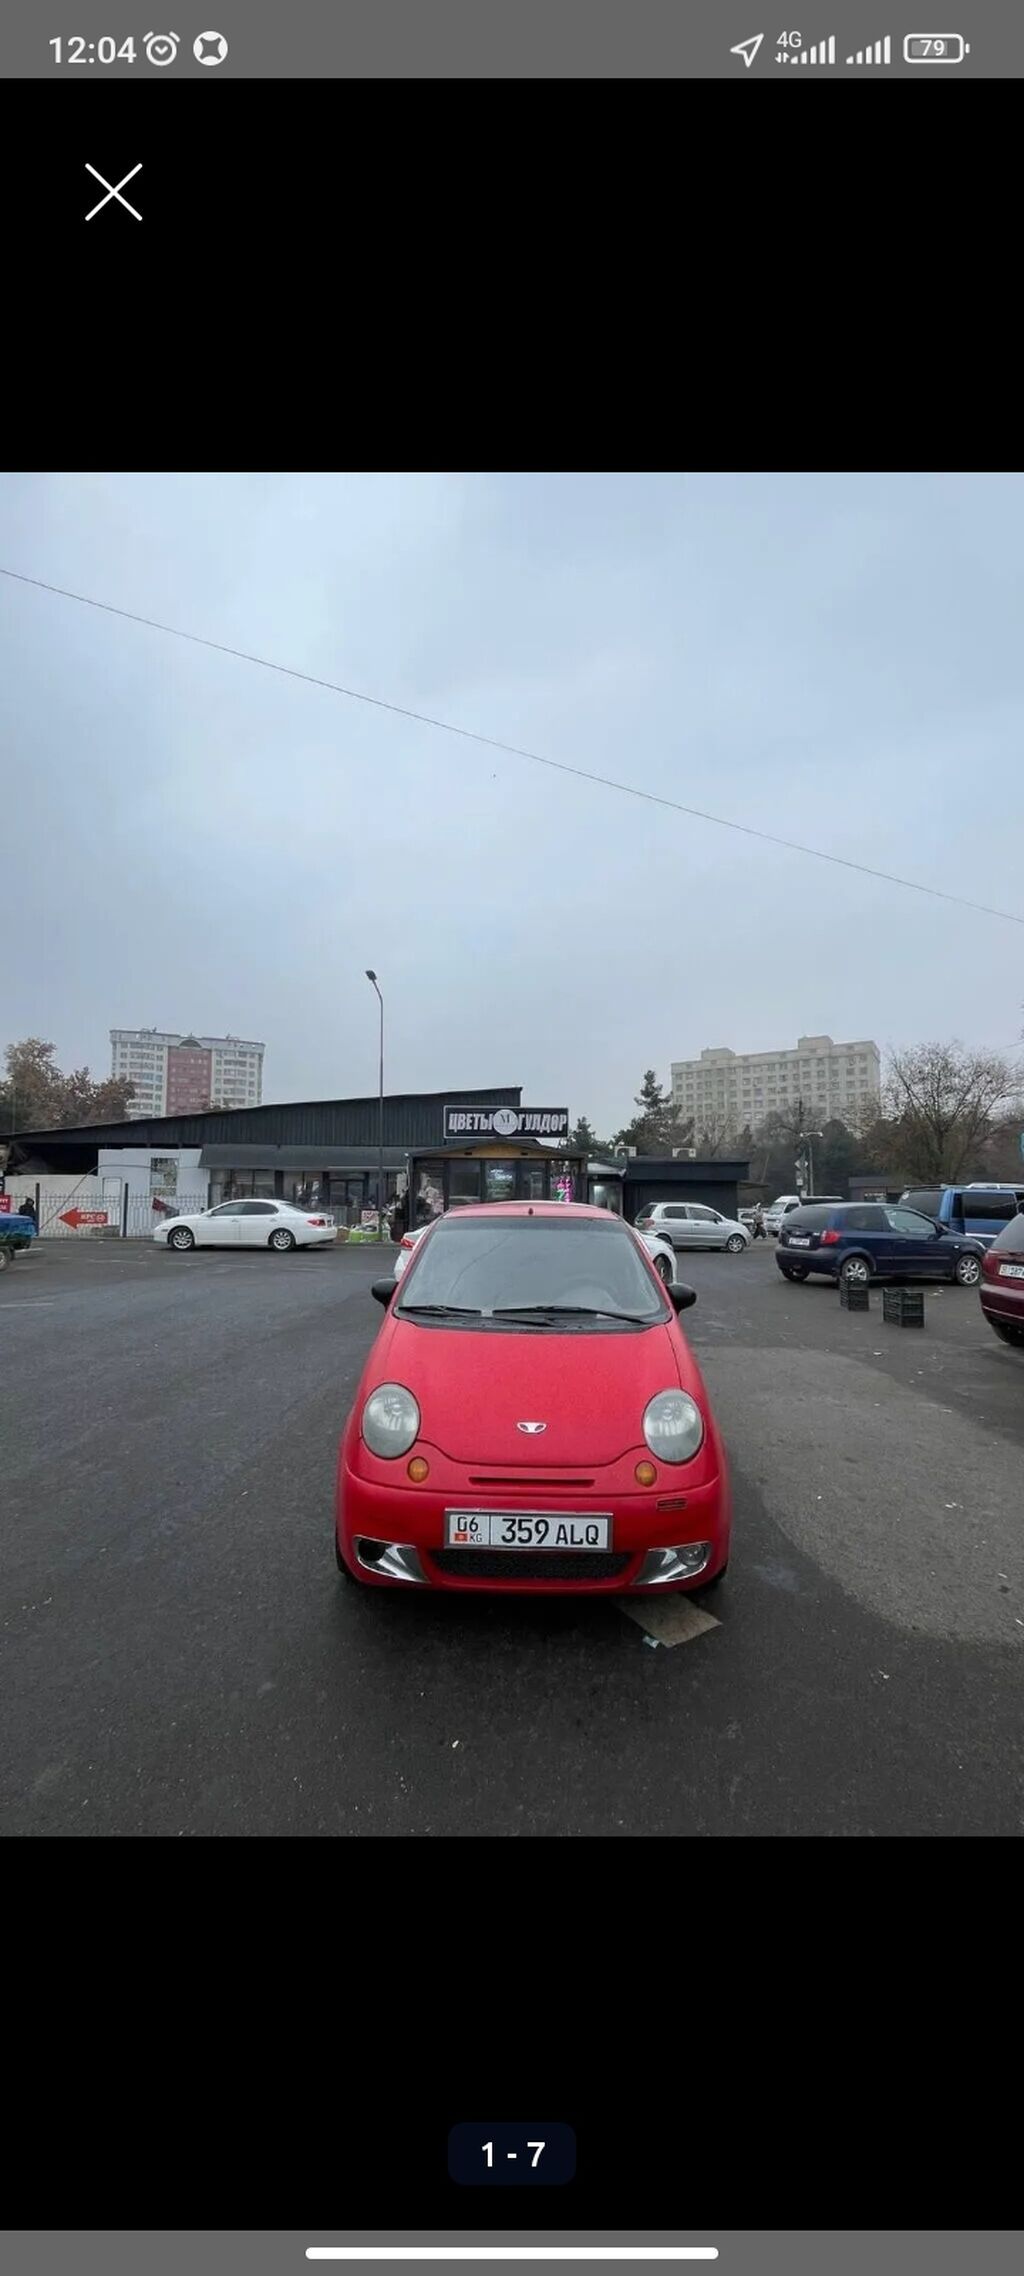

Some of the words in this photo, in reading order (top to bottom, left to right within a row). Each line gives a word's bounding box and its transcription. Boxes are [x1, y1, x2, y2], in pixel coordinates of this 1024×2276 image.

[448, 1113, 494, 1133] ЦВЕТЫ
[457, 1516, 479, 1532] 06
[501, 1518, 550, 1544] 359
[555, 1524, 599, 1545] ALQ
[469, 1533, 483, 1543] KG
